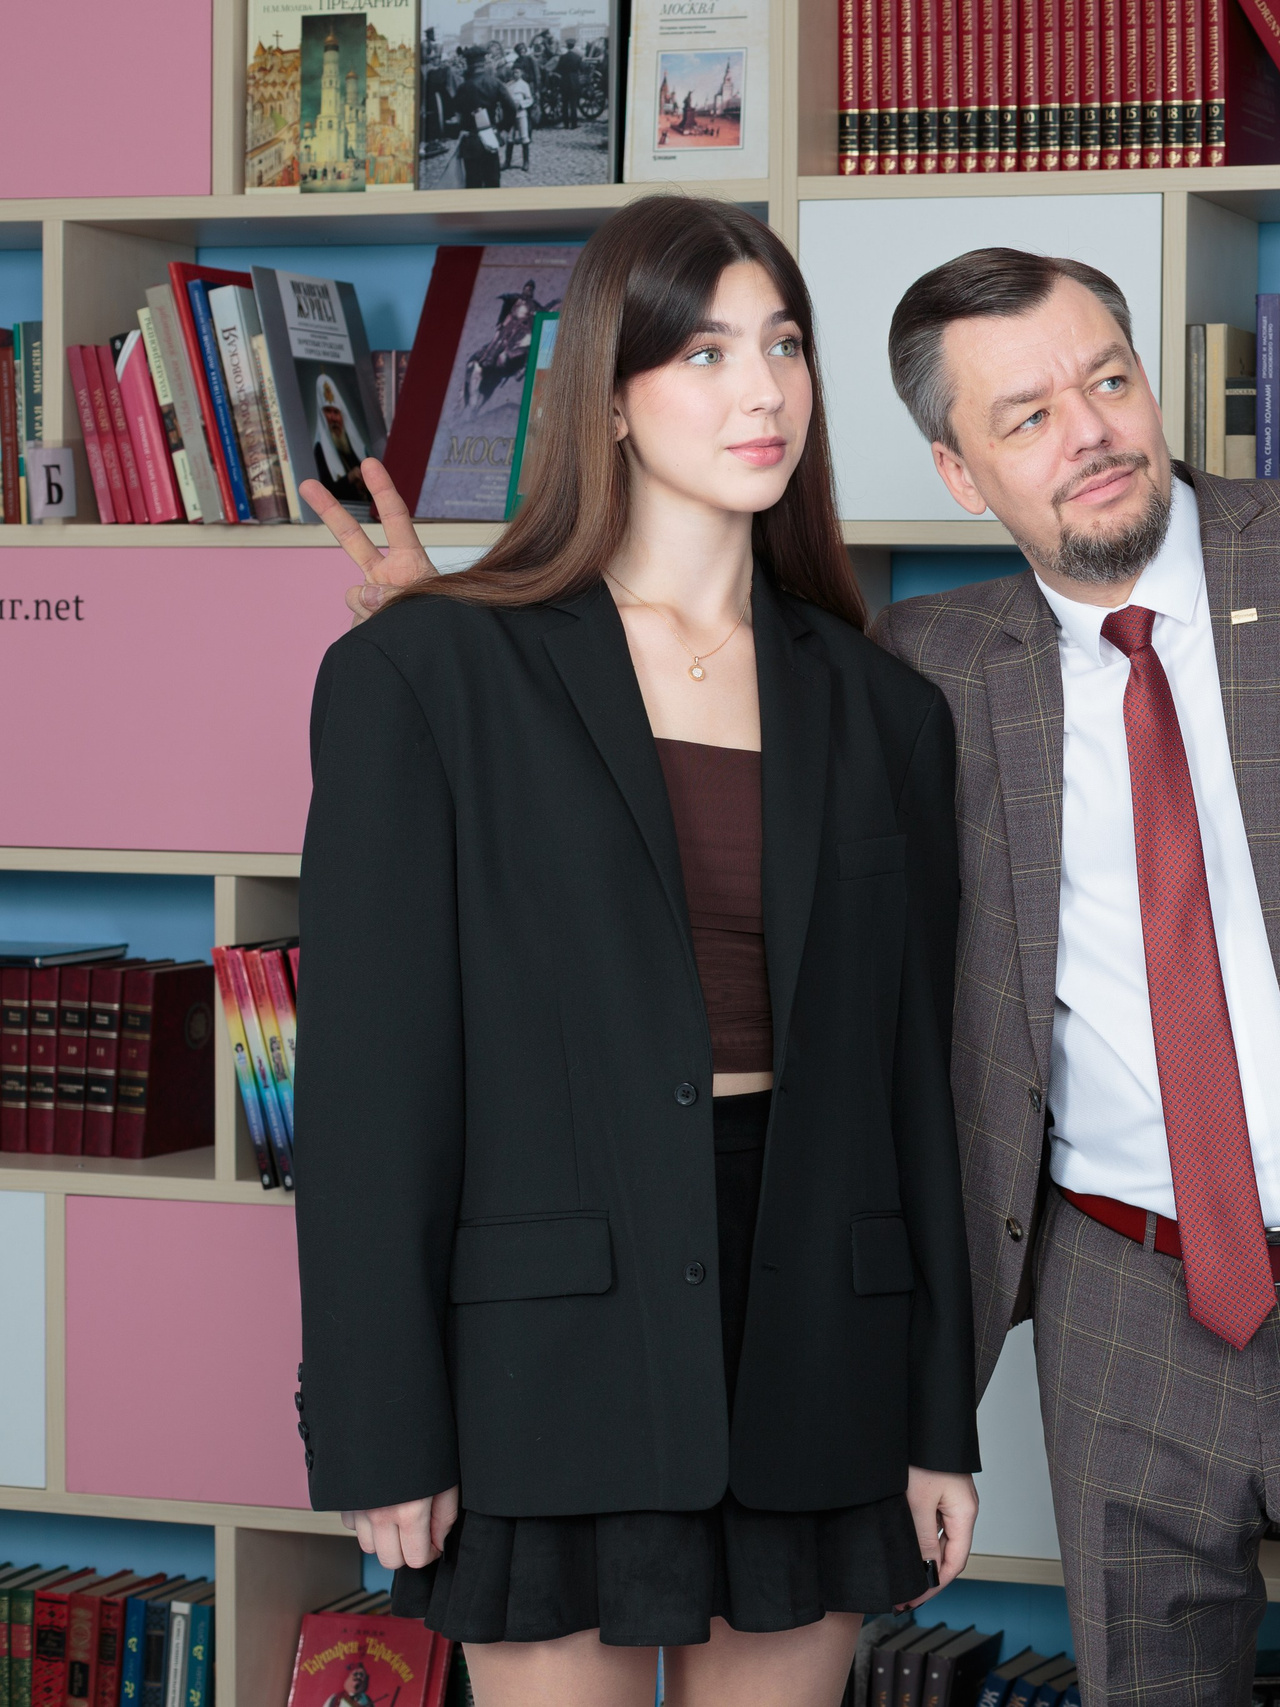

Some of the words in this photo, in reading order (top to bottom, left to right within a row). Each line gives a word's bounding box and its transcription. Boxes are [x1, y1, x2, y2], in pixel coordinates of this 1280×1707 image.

[843, 38, 853, 102] BRITANNICA
[882, 37, 892, 101] BRITANNICA
[922, 36, 932, 100] BRITANNICA
[963, 34, 973, 99] BRITANNICA
[1003, 33, 1013, 98] BRITANNICA
[1044, 32, 1054, 96] BRITANNICA
[1085, 30, 1094, 96] BRITANNICA
[1127, 29, 1137, 94] BRITANNICA
[1167, 28, 1177, 93] BRITANNICA
[1209, 26, 1219, 91] BRITANNICA
[846, 116, 850, 126] 1
[884, 115, 890, 126] 3
[924, 114, 930, 124] 5
[965, 112, 972, 123] 7
[1004, 112, 1012, 123] 9
[1045, 111, 1053, 122] 11
[1085, 110, 1096, 120] 13
[1126, 108, 1137, 119] 15
[1167, 108, 1178, 119] 18
[1209, 106, 1220, 117] 19
[32, 341, 42, 394] МОСКВА
[144, 316, 170, 400] КОЛЛЕКЦИОНЕРЫ
[222, 326, 253, 425] МОСКОВСКАЯ
[1264, 427, 1272, 455] СЕМЬЮ
[45, 461, 66, 506] Б
[1264, 458, 1272, 476] ПОД
[67, 1045, 77, 1055] 10
[96, 1047, 106, 1056] 11
